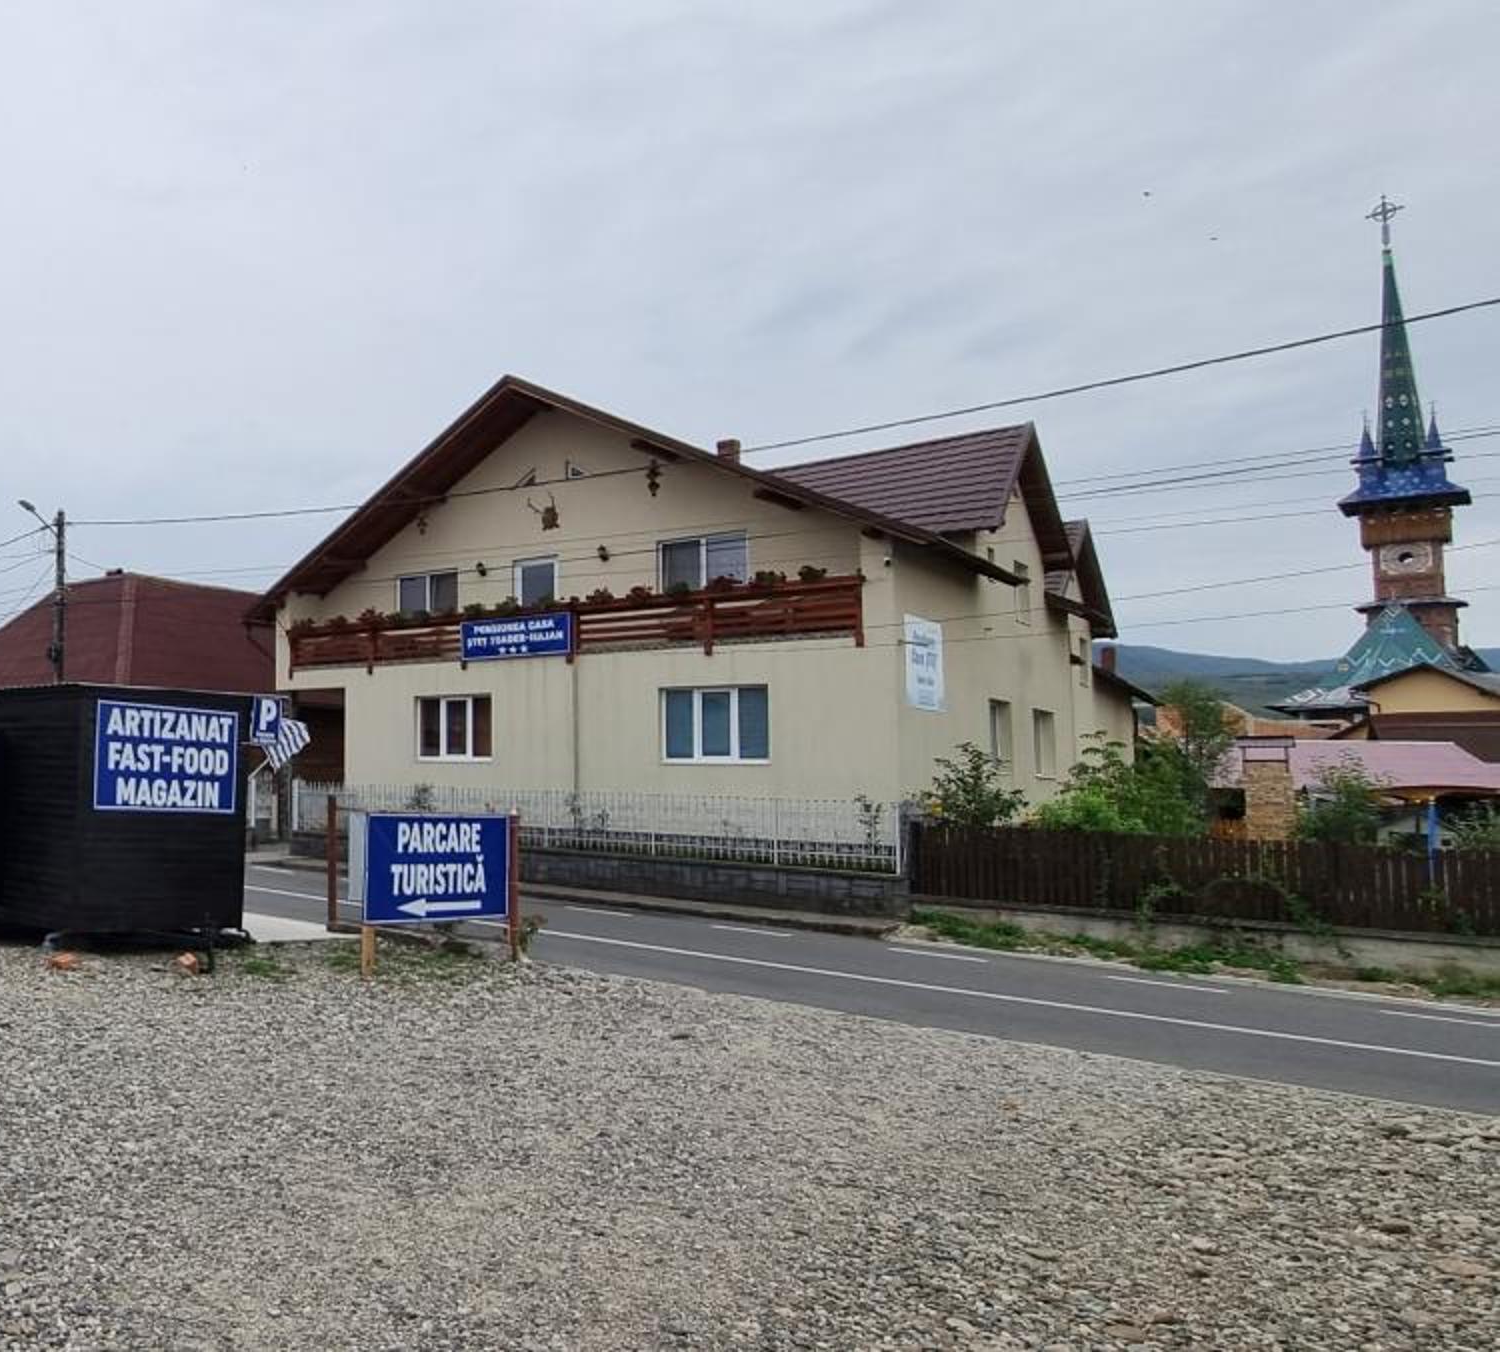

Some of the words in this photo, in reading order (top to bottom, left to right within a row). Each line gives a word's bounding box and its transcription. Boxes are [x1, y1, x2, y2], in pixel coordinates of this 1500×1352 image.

[527, 619, 555, 631] CASA
[106, 707, 232, 743] ARTIZANAT
[259, 699, 277, 731] P
[107, 741, 229, 776] FAST-FOOD
[116, 776, 219, 808] MAGAZIN
[397, 822, 482, 853] PARCARE
[391, 854, 486, 896] TURISTICĂ
